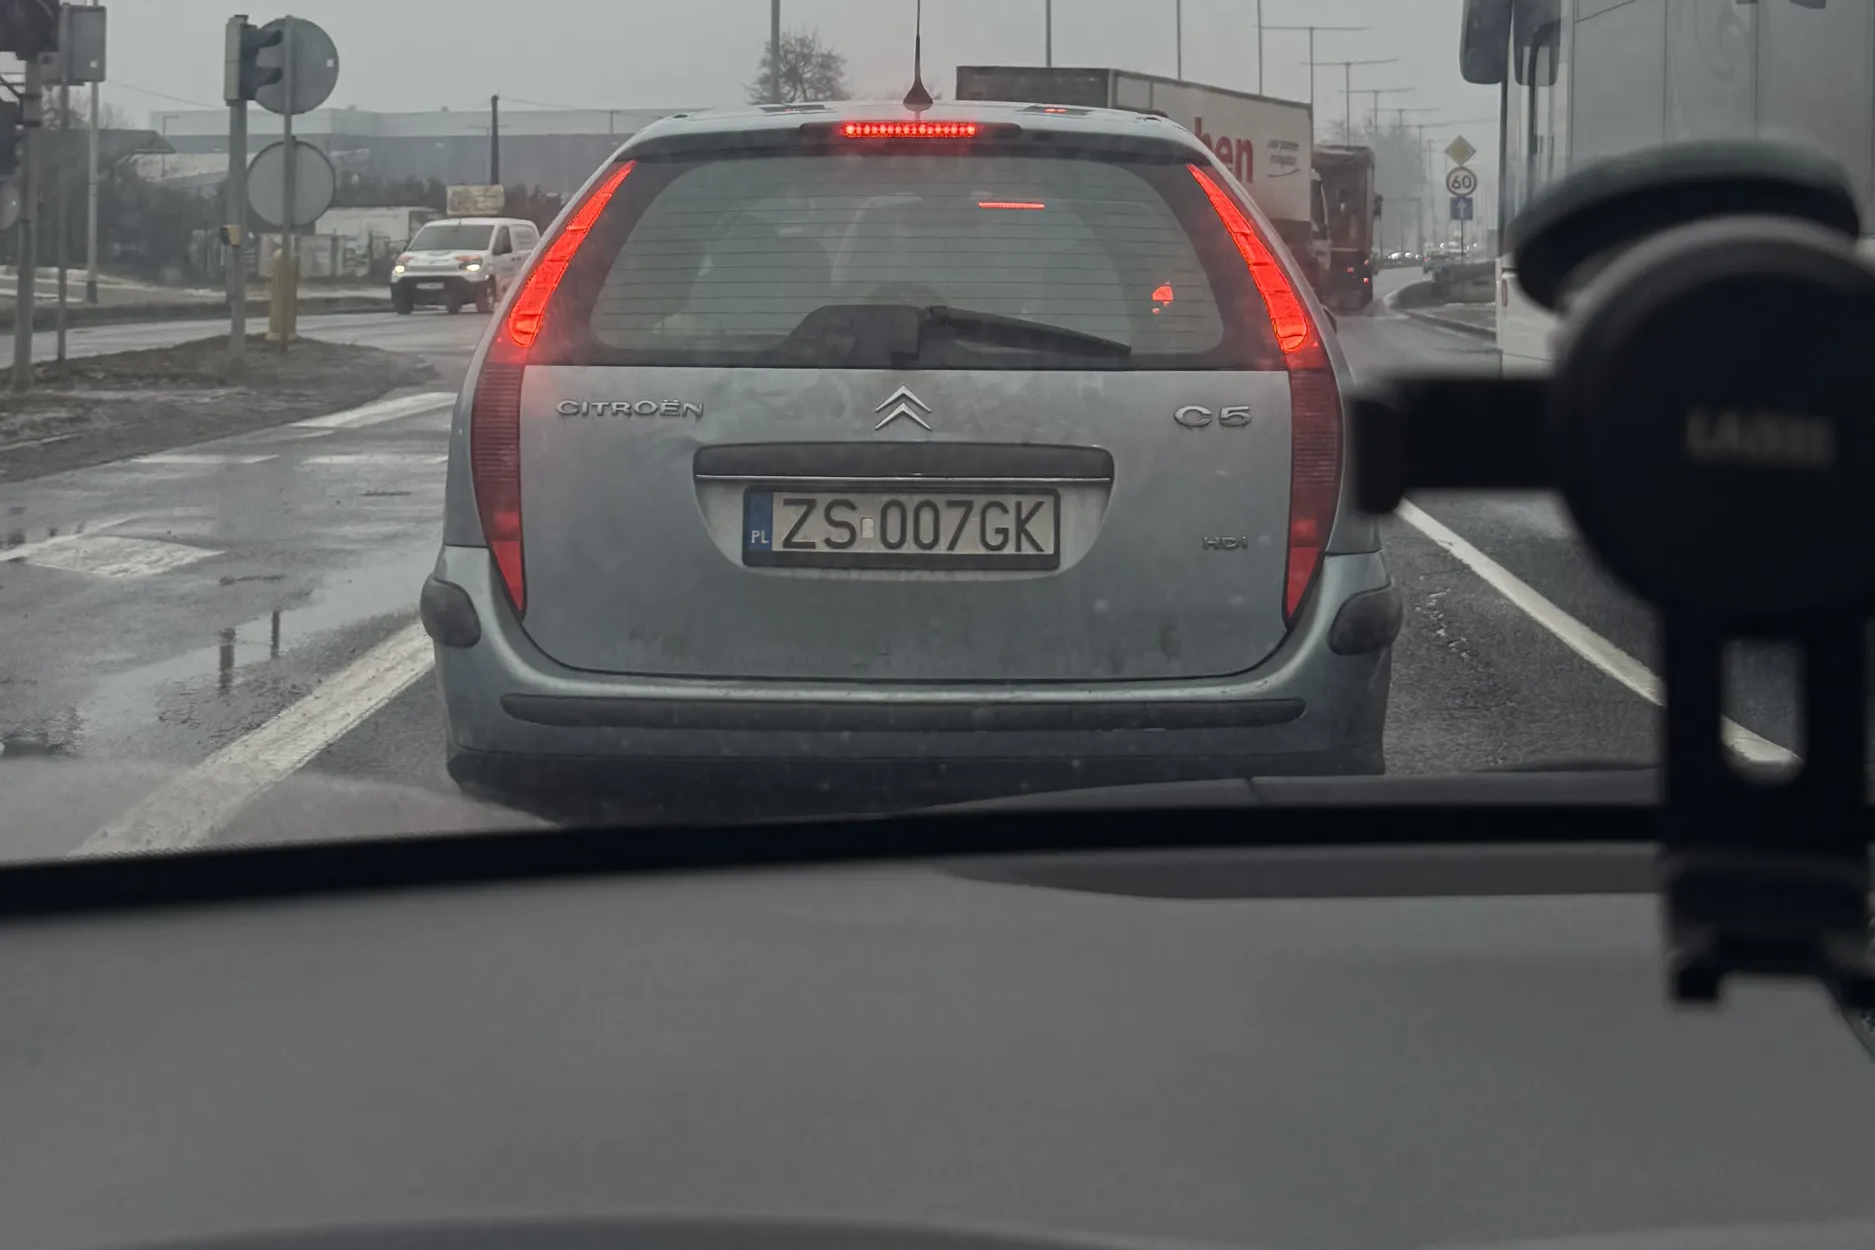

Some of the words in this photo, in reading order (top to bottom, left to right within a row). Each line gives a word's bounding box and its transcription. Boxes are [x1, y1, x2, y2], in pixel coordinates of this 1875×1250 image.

[1451, 174, 1472, 189] 60
[556, 397, 704, 418] CITROËN
[781, 497, 858, 550] ZS
[879, 498, 1046, 553] 007GK
[750, 529, 770, 545] PL
